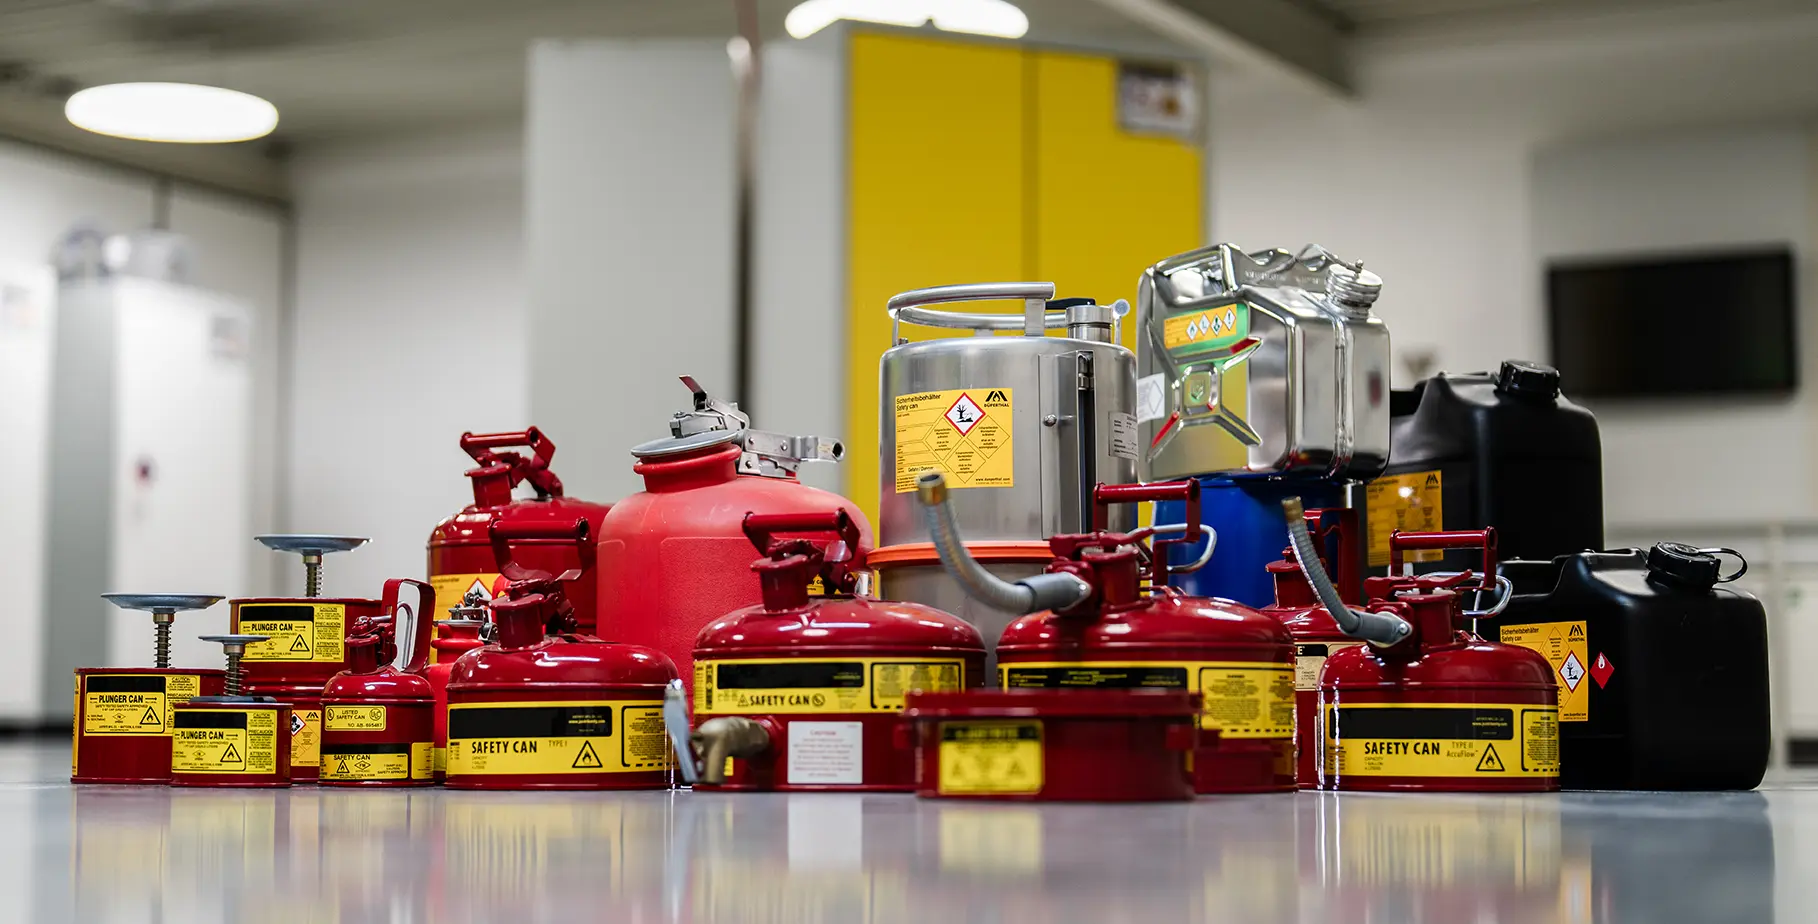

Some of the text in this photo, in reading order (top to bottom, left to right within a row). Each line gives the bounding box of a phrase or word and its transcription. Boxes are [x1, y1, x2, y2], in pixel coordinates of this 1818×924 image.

[251, 623, 293, 631] PLUNGER CAN
[98, 695, 144, 703] PLUNGER CAN
[750, 694, 810, 706] SAFETY CAN
[180, 731, 224, 740] PLUNGER CAN
[471, 740, 537, 754] SAFETY CAN
[548, 740, 564, 748] TYPE
[1451, 741, 1465, 749] TYPE
[1364, 742, 1440, 755] SAFETY CAN
